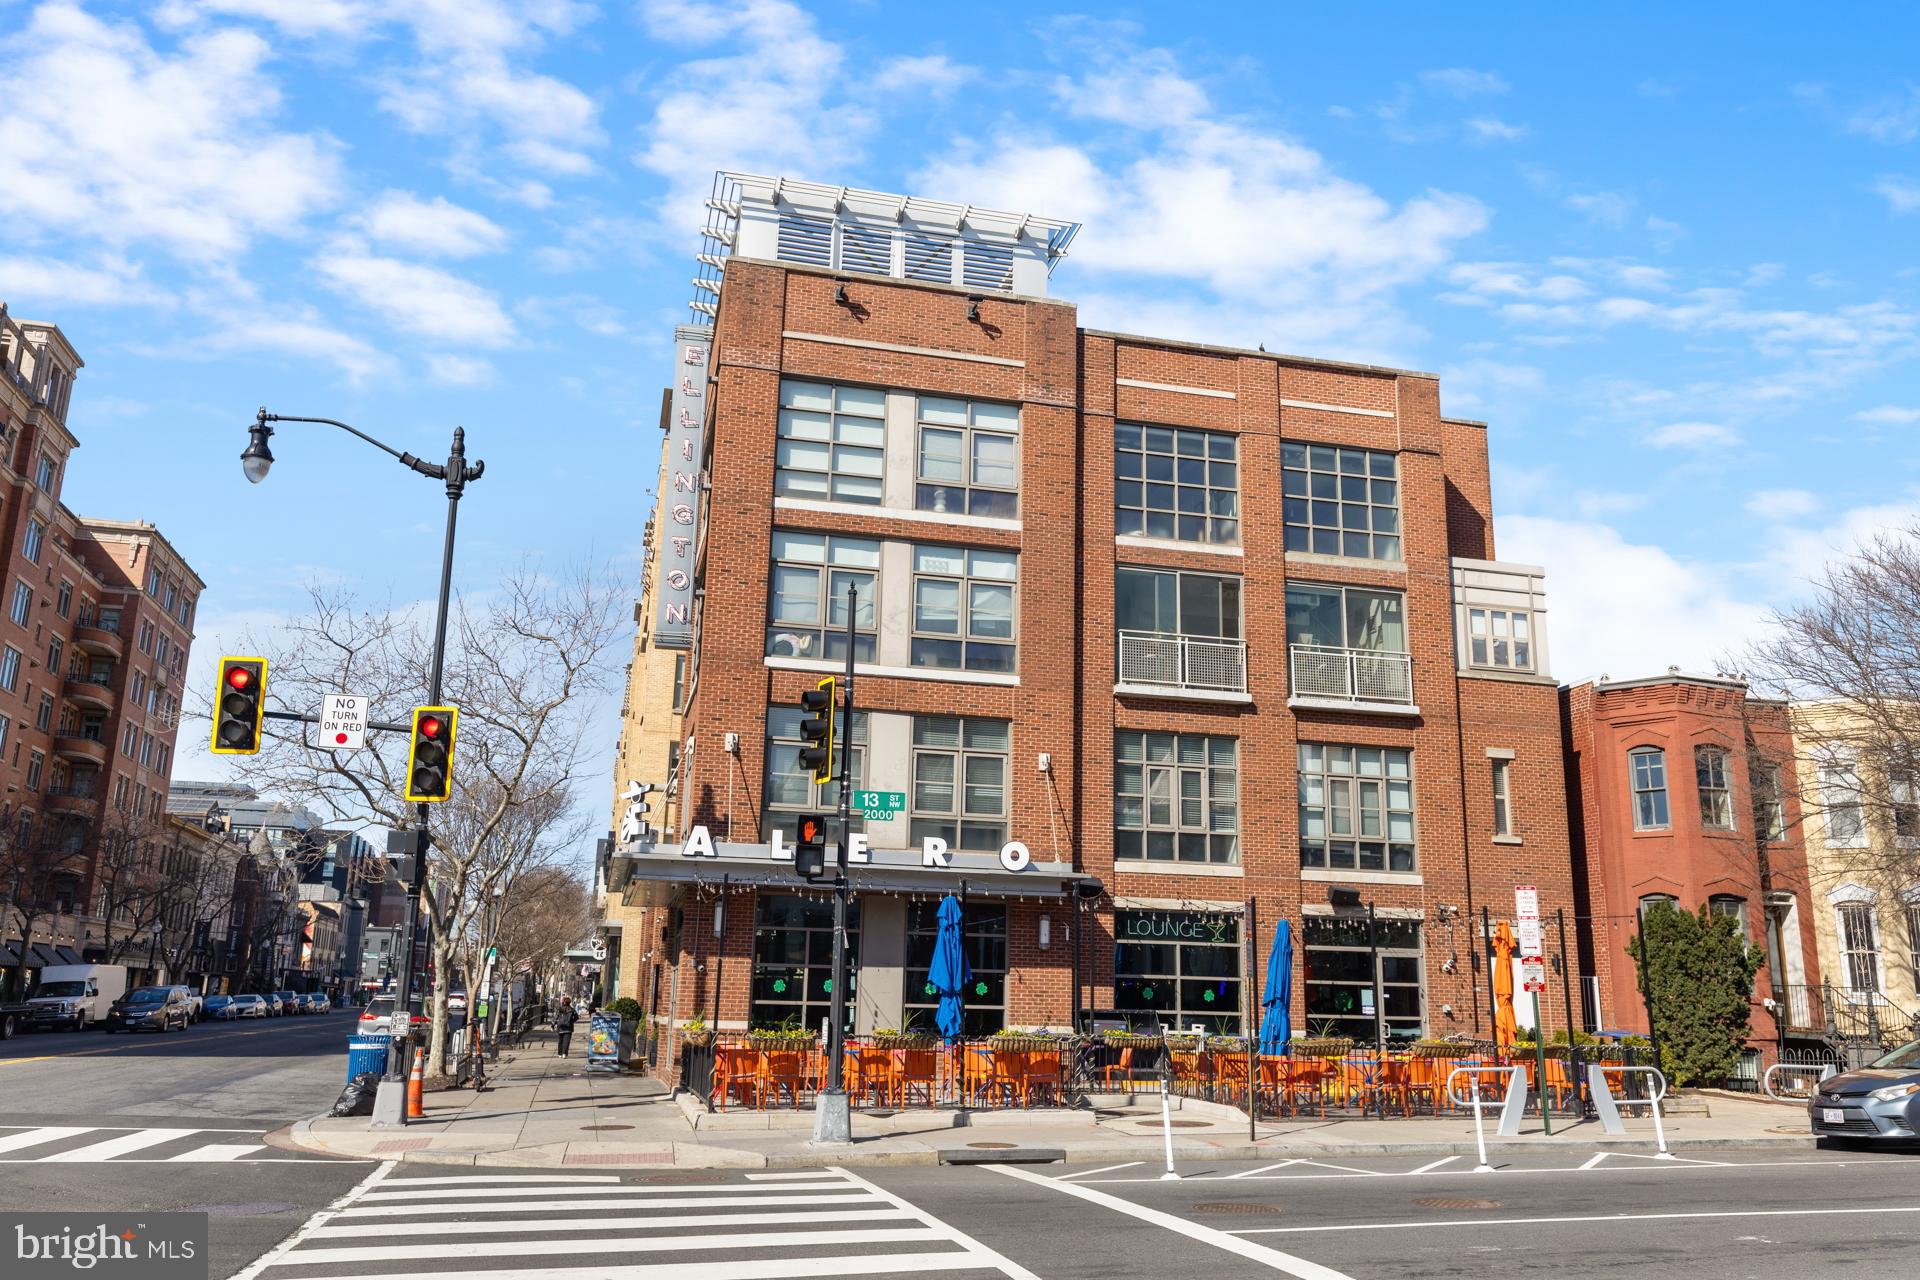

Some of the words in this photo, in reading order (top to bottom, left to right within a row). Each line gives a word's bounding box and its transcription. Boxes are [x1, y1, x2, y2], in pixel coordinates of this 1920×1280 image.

[665, 345, 704, 626] ELLINGTON
[335, 698, 356, 709] NO
[332, 711, 358, 720] TURN
[324, 721, 338, 730] ON
[342, 722, 362, 732] RED
[861, 792, 879, 807] 13
[889, 794, 900, 802] ST
[864, 809, 893, 820] 2000
[682, 825, 1030, 871] ALERO
[1127, 919, 1204, 938] LOUNGE
